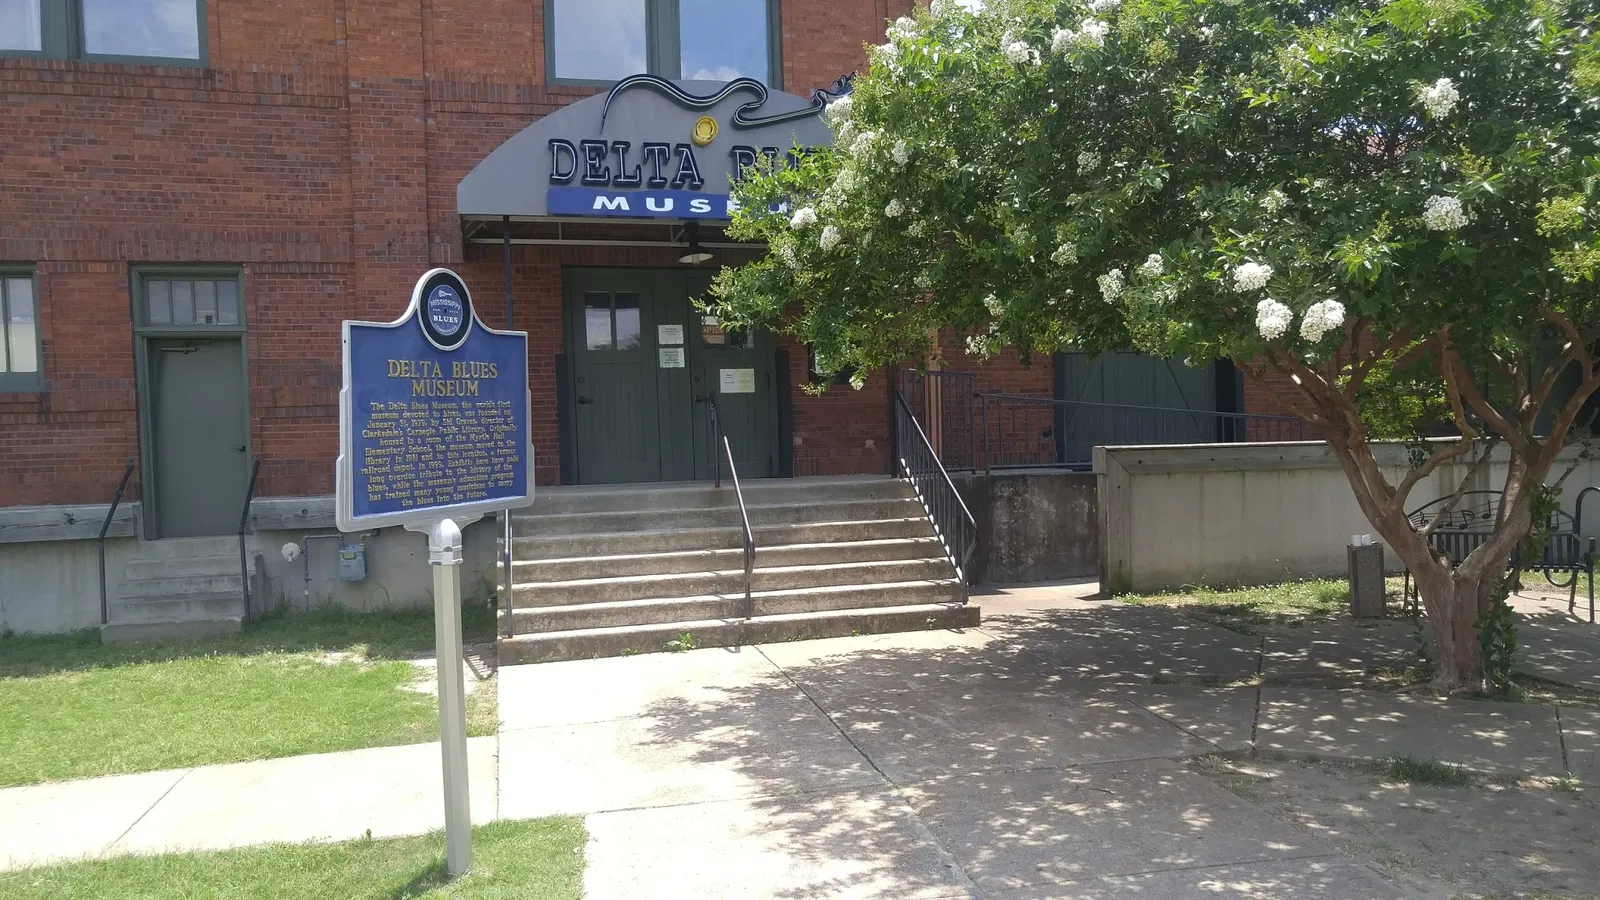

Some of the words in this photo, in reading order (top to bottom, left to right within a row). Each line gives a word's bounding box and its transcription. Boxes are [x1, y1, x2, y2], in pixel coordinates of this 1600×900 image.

[548, 138, 704, 189] DELTA
[592, 195, 788, 213] MUSEU
[430, 299, 460, 310] MISSISSIPPI
[432, 315, 458, 324] BLUES
[388, 360, 442, 378] DELTA
[452, 362, 498, 378] BLUES
[412, 380, 479, 397] MUSEUM
[370, 402, 384, 410] The
[388, 402, 408, 410] Delta
[412, 402, 428, 410] Blues
[462, 400, 472, 408] the
[367, 420, 396, 428] January
[431, 419, 440, 427] by
[362, 429, 404, 438] Clarksdale's
[407, 428, 436, 437] Carnegie
[438, 426, 458, 434] Public
[380, 437, 404, 446] housed
[470, 433, 489, 442] Myrtle
[365, 447, 405, 456] Elementary
[361, 465, 390, 474] railroad
[448, 459, 472, 467] Exhibits
[507, 455, 518, 463] paid
[366, 456, 391, 465] library
[368, 484, 388, 492] blues,
[392, 481, 410, 489] while
[413, 480, 424, 488] the
[492, 472, 514, 480] program
[370, 475, 384, 484] long
[388, 473, 416, 481] overdue
[420, 470, 442, 478] tribute
[369, 494, 381, 502] has
[384, 490, 410, 499] trained
[414, 488, 432, 496] many
[435, 486, 454, 495] young
[457, 482, 486, 491] musicians
[402, 498, 414, 506] the
[417, 497, 434, 505] blues
